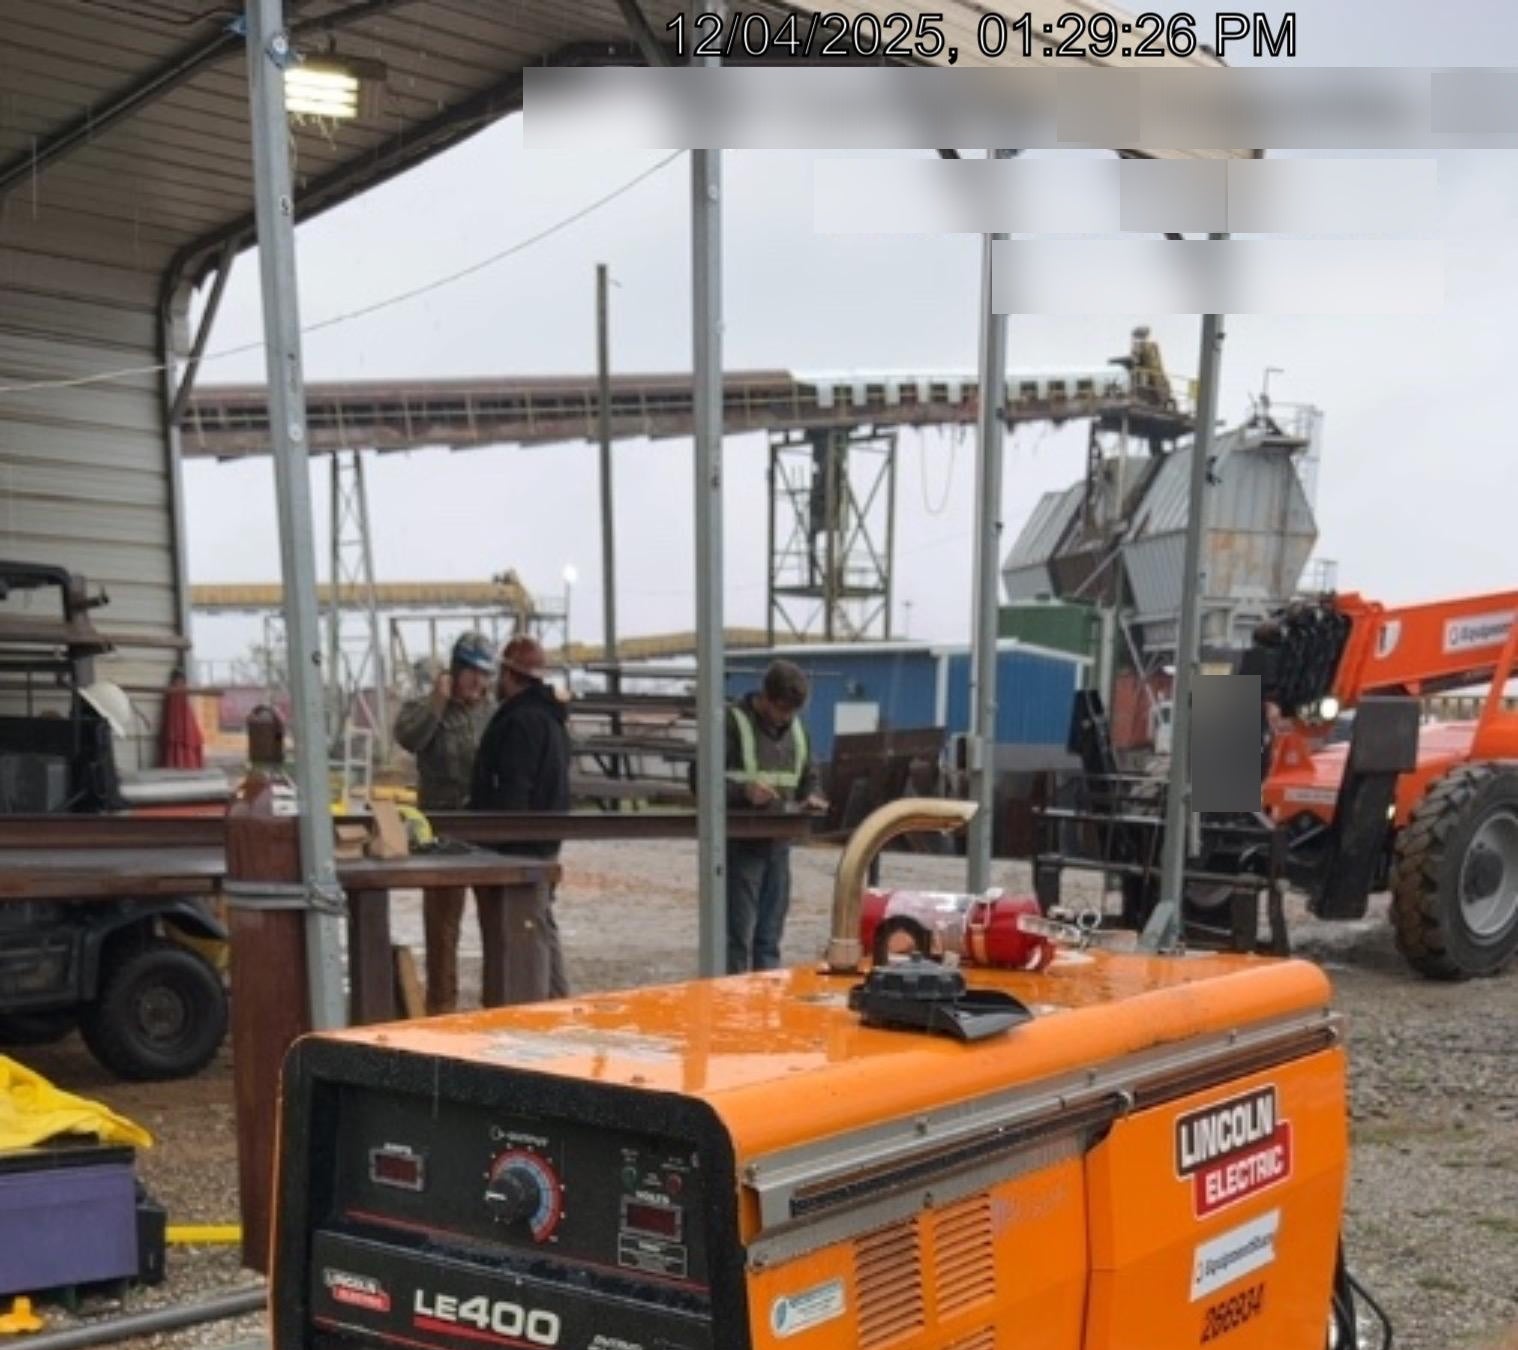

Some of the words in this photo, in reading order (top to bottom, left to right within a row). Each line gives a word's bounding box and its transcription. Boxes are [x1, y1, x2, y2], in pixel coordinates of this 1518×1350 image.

[1180, 1094, 1274, 1169] LINCOLN
[1205, 1145, 1285, 1206] ELECTRIC
[413, 1288, 561, 1346] LE400
